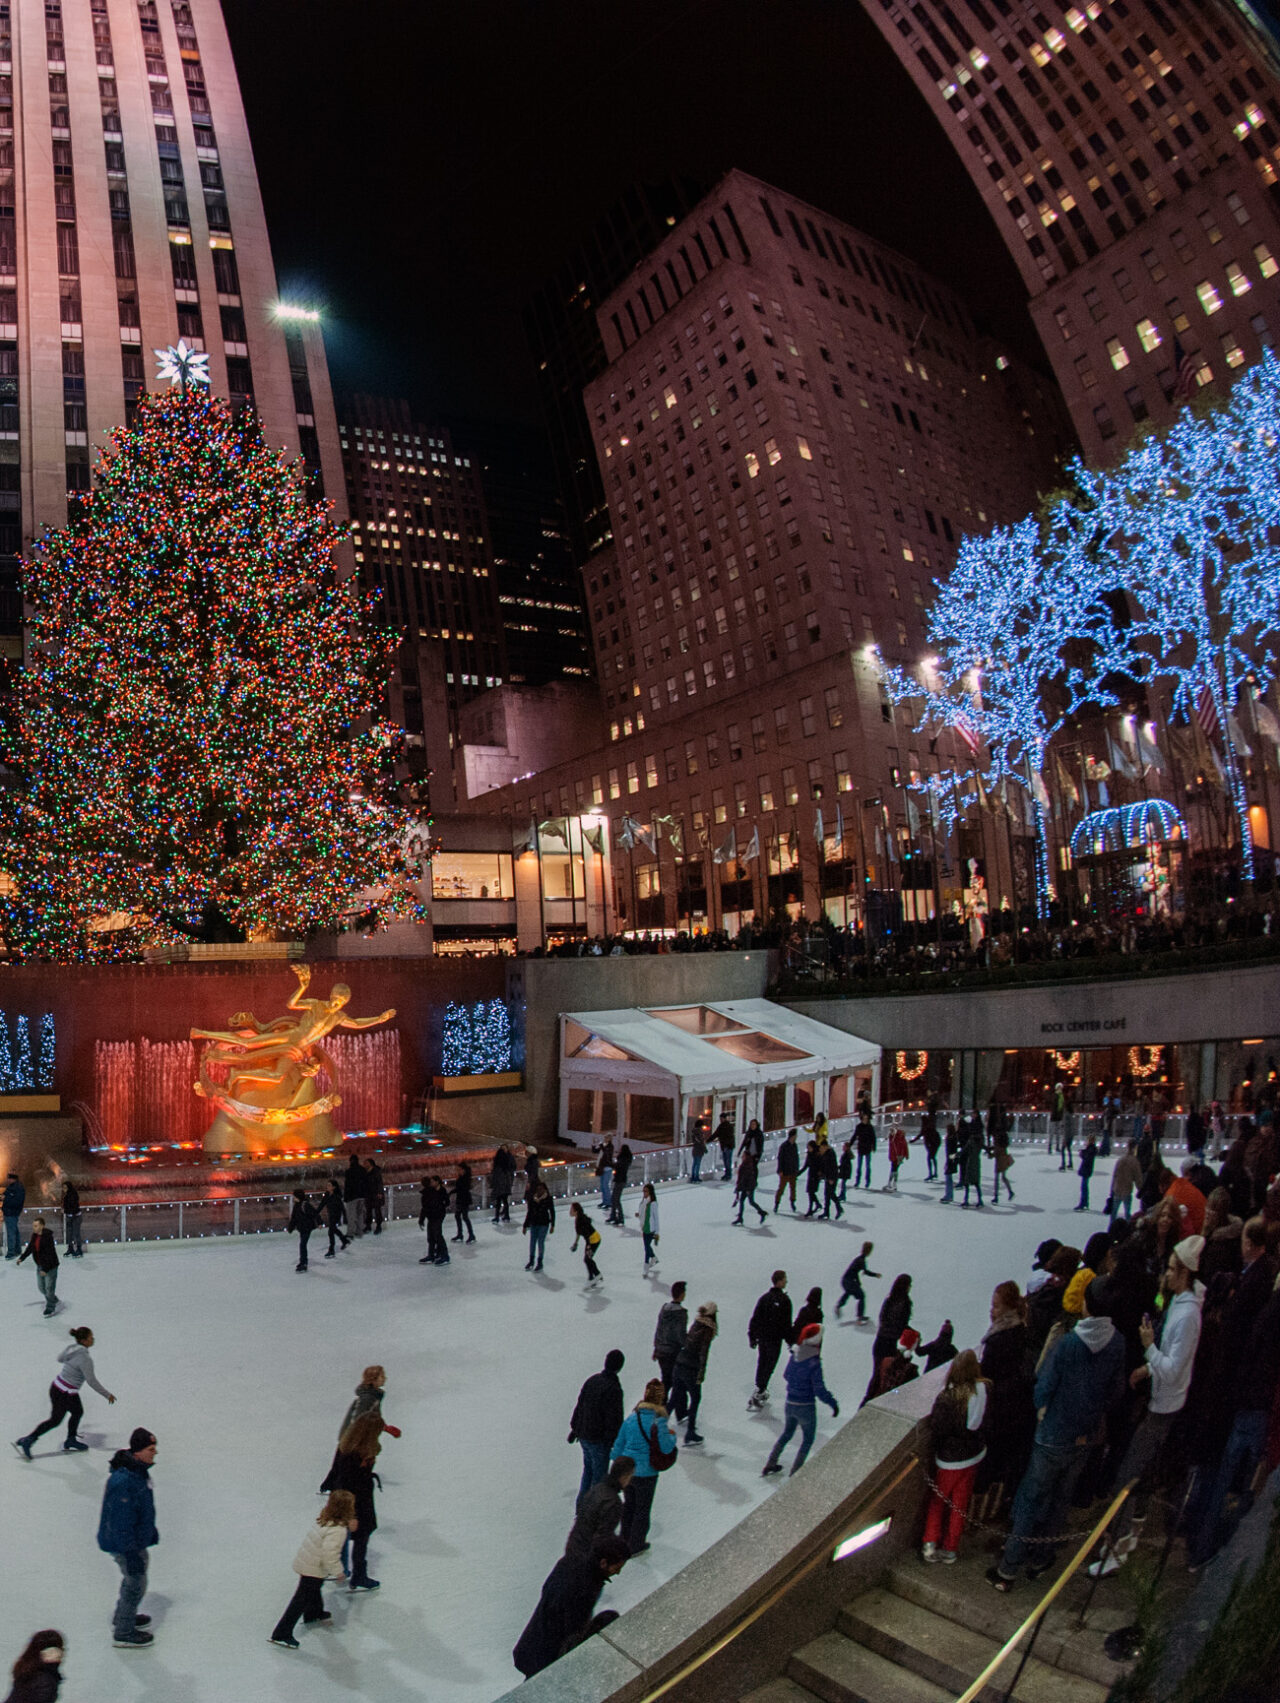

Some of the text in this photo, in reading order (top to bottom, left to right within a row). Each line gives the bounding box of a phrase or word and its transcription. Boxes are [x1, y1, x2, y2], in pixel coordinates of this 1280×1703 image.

[1041, 1017, 1126, 1033] ROCK CENTER CAFÉ
